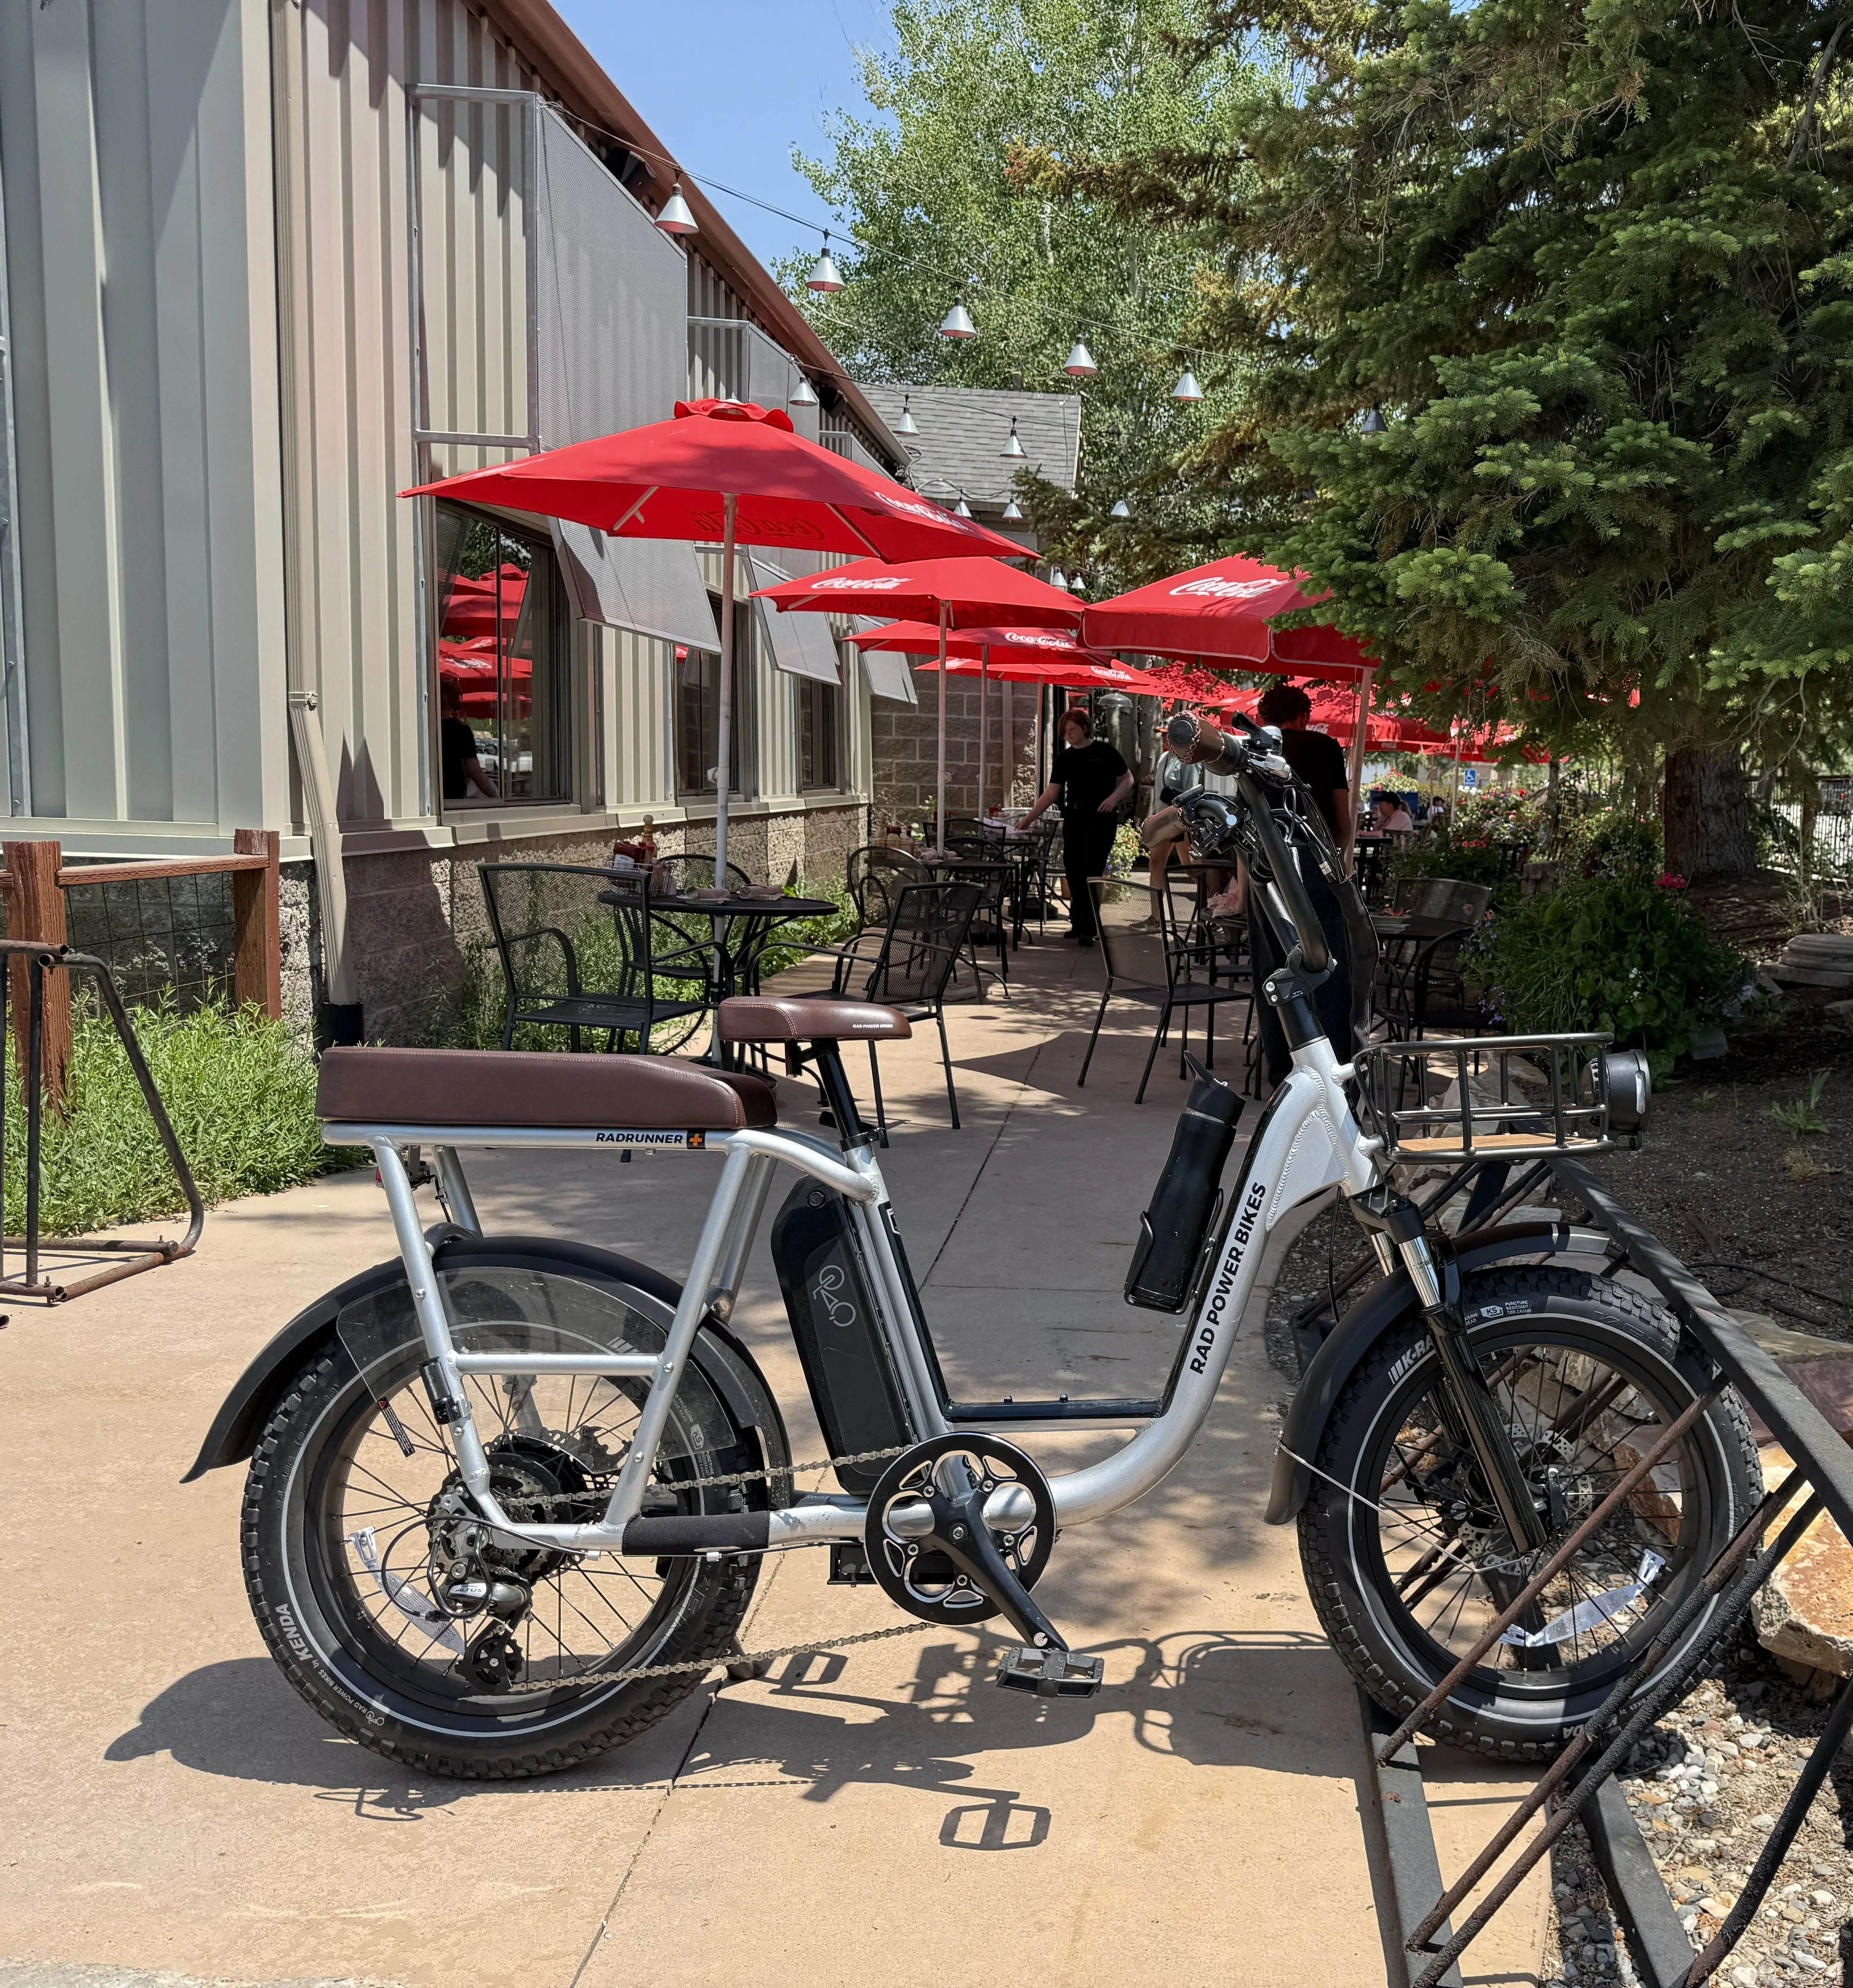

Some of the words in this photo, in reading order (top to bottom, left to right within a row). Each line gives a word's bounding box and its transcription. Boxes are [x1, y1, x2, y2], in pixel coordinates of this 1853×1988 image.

[596, 1133, 683, 1143] RADRUNNER
[1190, 1323, 1215, 1375] RAD
[1206, 1246, 1244, 1326] POWER
[1234, 1181, 1266, 1245] BIKES
[1464, 1312, 1478, 1321] ASING
[1401, 1334, 1435, 1370] K-RA
[275, 1603, 314, 1661] KENDA
[311, 1659, 319, 1668] by
[318, 1669, 335, 1687] BIKES
[333, 1685, 356, 1704] POWER
[354, 1702, 368, 1713] RAD
